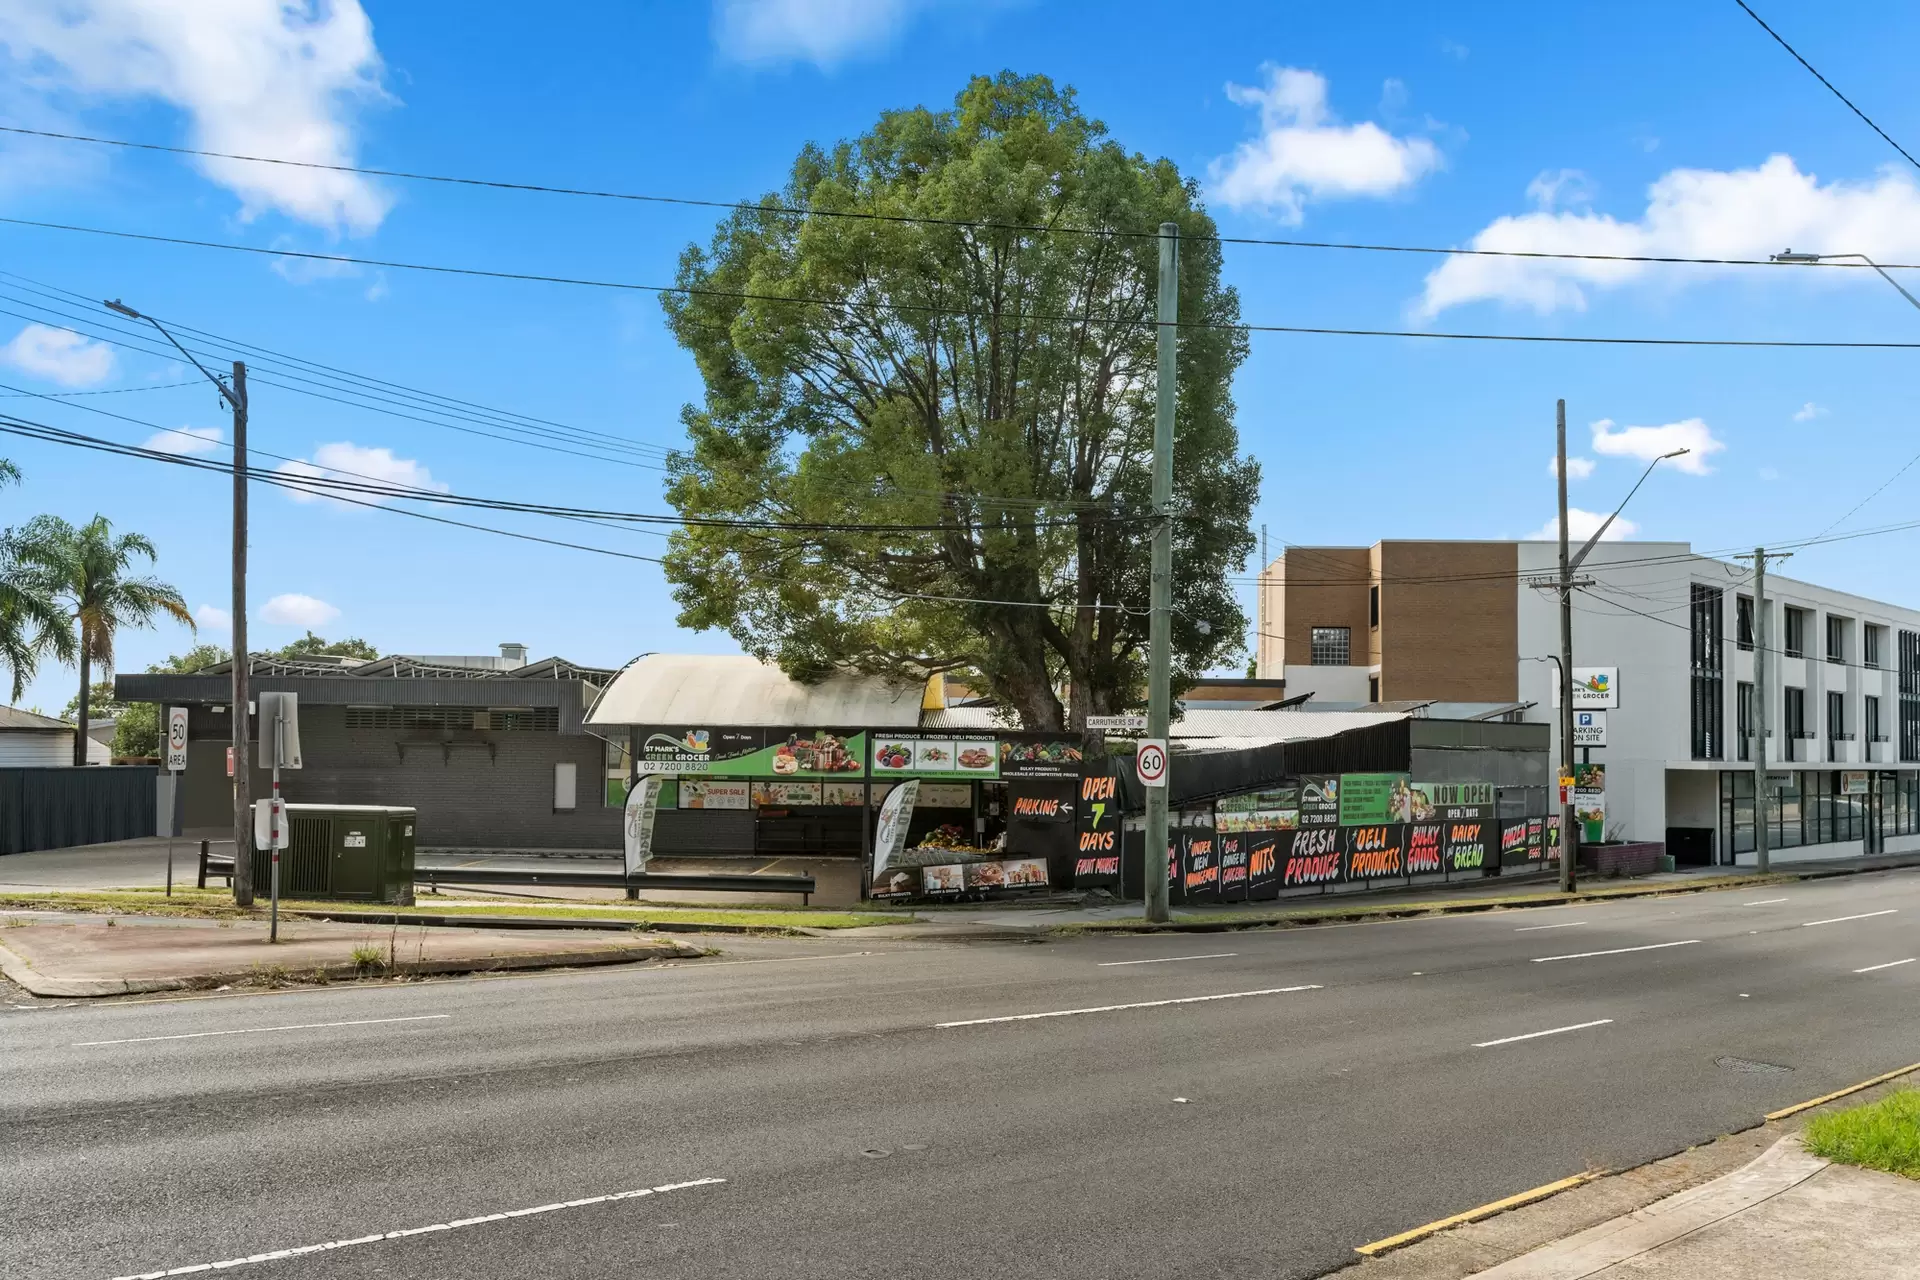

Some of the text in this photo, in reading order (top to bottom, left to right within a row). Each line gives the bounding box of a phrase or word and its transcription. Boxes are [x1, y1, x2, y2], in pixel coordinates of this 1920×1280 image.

[1582, 715, 1589, 724] P
[173, 724, 184, 740] 50
[169, 754, 185, 765] AREA
[644, 762, 708, 771] 02 7200 8820
[1143, 755, 1161, 770] 60
[1082, 776, 1116, 800] OPEN
[1434, 784, 1491, 804] NOW OPEN
[1014, 797, 1059, 816] PARKING
[1091, 803, 1105, 829] 7
[1448, 806, 1478, 818] OPEN 7 DAYS
[1302, 815, 1309, 824] 02
[1310, 814, 1322, 823] 7200
[1324, 814, 1336, 822] 8820
[1080, 831, 1114, 851] DAYS
[1292, 829, 1337, 856] FRESH
[1356, 827, 1387, 850] DELI
[1411, 825, 1440, 848] BULKY
[1451, 824, 1481, 843] DAIRY
[1502, 822, 1526, 850] FROZEN
[1551, 829, 1557, 847] 7
[1191, 840, 1212, 857] UNDER
[1225, 840, 1238, 854] BIG
[1075, 857, 1119, 876] FRUIT MARKET
[1193, 854, 1209, 872] NEW
[1223, 853, 1239, 868] RANGE
[1250, 844, 1276, 881] NUTS
[1350, 847, 1400, 879] PRODUCTS
[1407, 845, 1440, 873] GOODS
[1454, 844, 1483, 870] BREAD
[1284, 852, 1340, 886] PRODUCE
